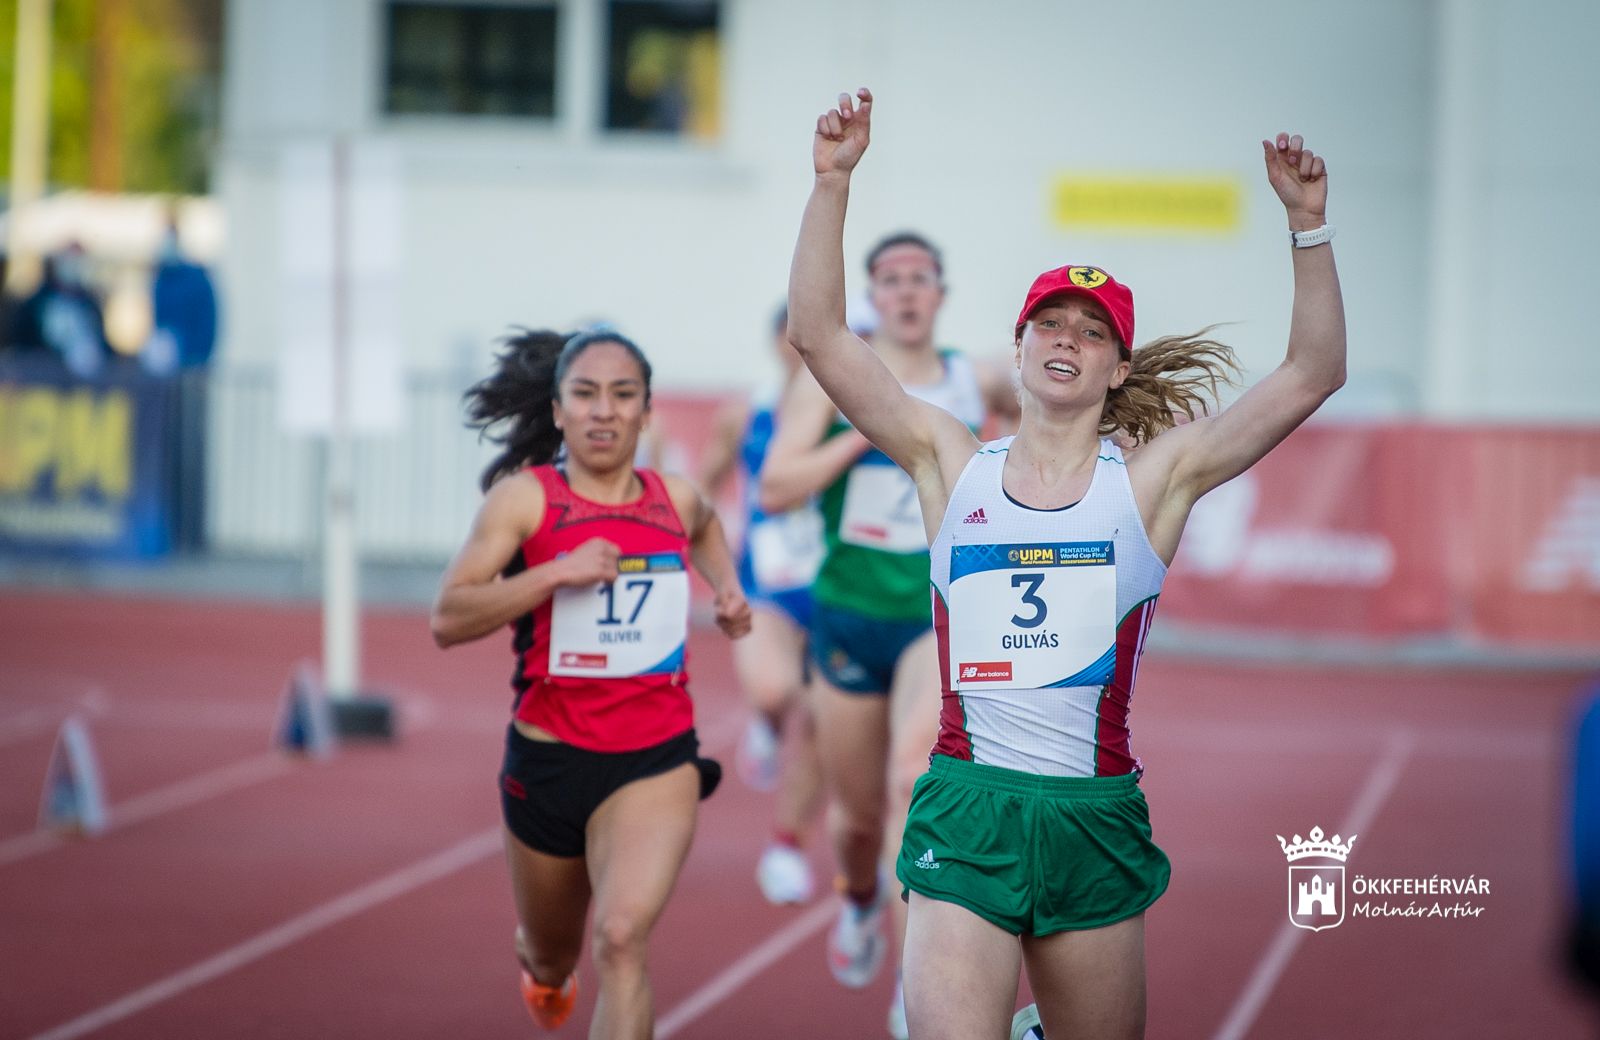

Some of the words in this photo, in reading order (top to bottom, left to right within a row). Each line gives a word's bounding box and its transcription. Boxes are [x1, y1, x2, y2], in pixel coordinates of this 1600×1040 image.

[1020, 549, 1053, 560] UIPM
[597, 580, 654, 625] 17
[1011, 573, 1048, 629] 3
[598, 631, 642, 643] OLIVER
[1002, 629, 1059, 650] GULYÁS
